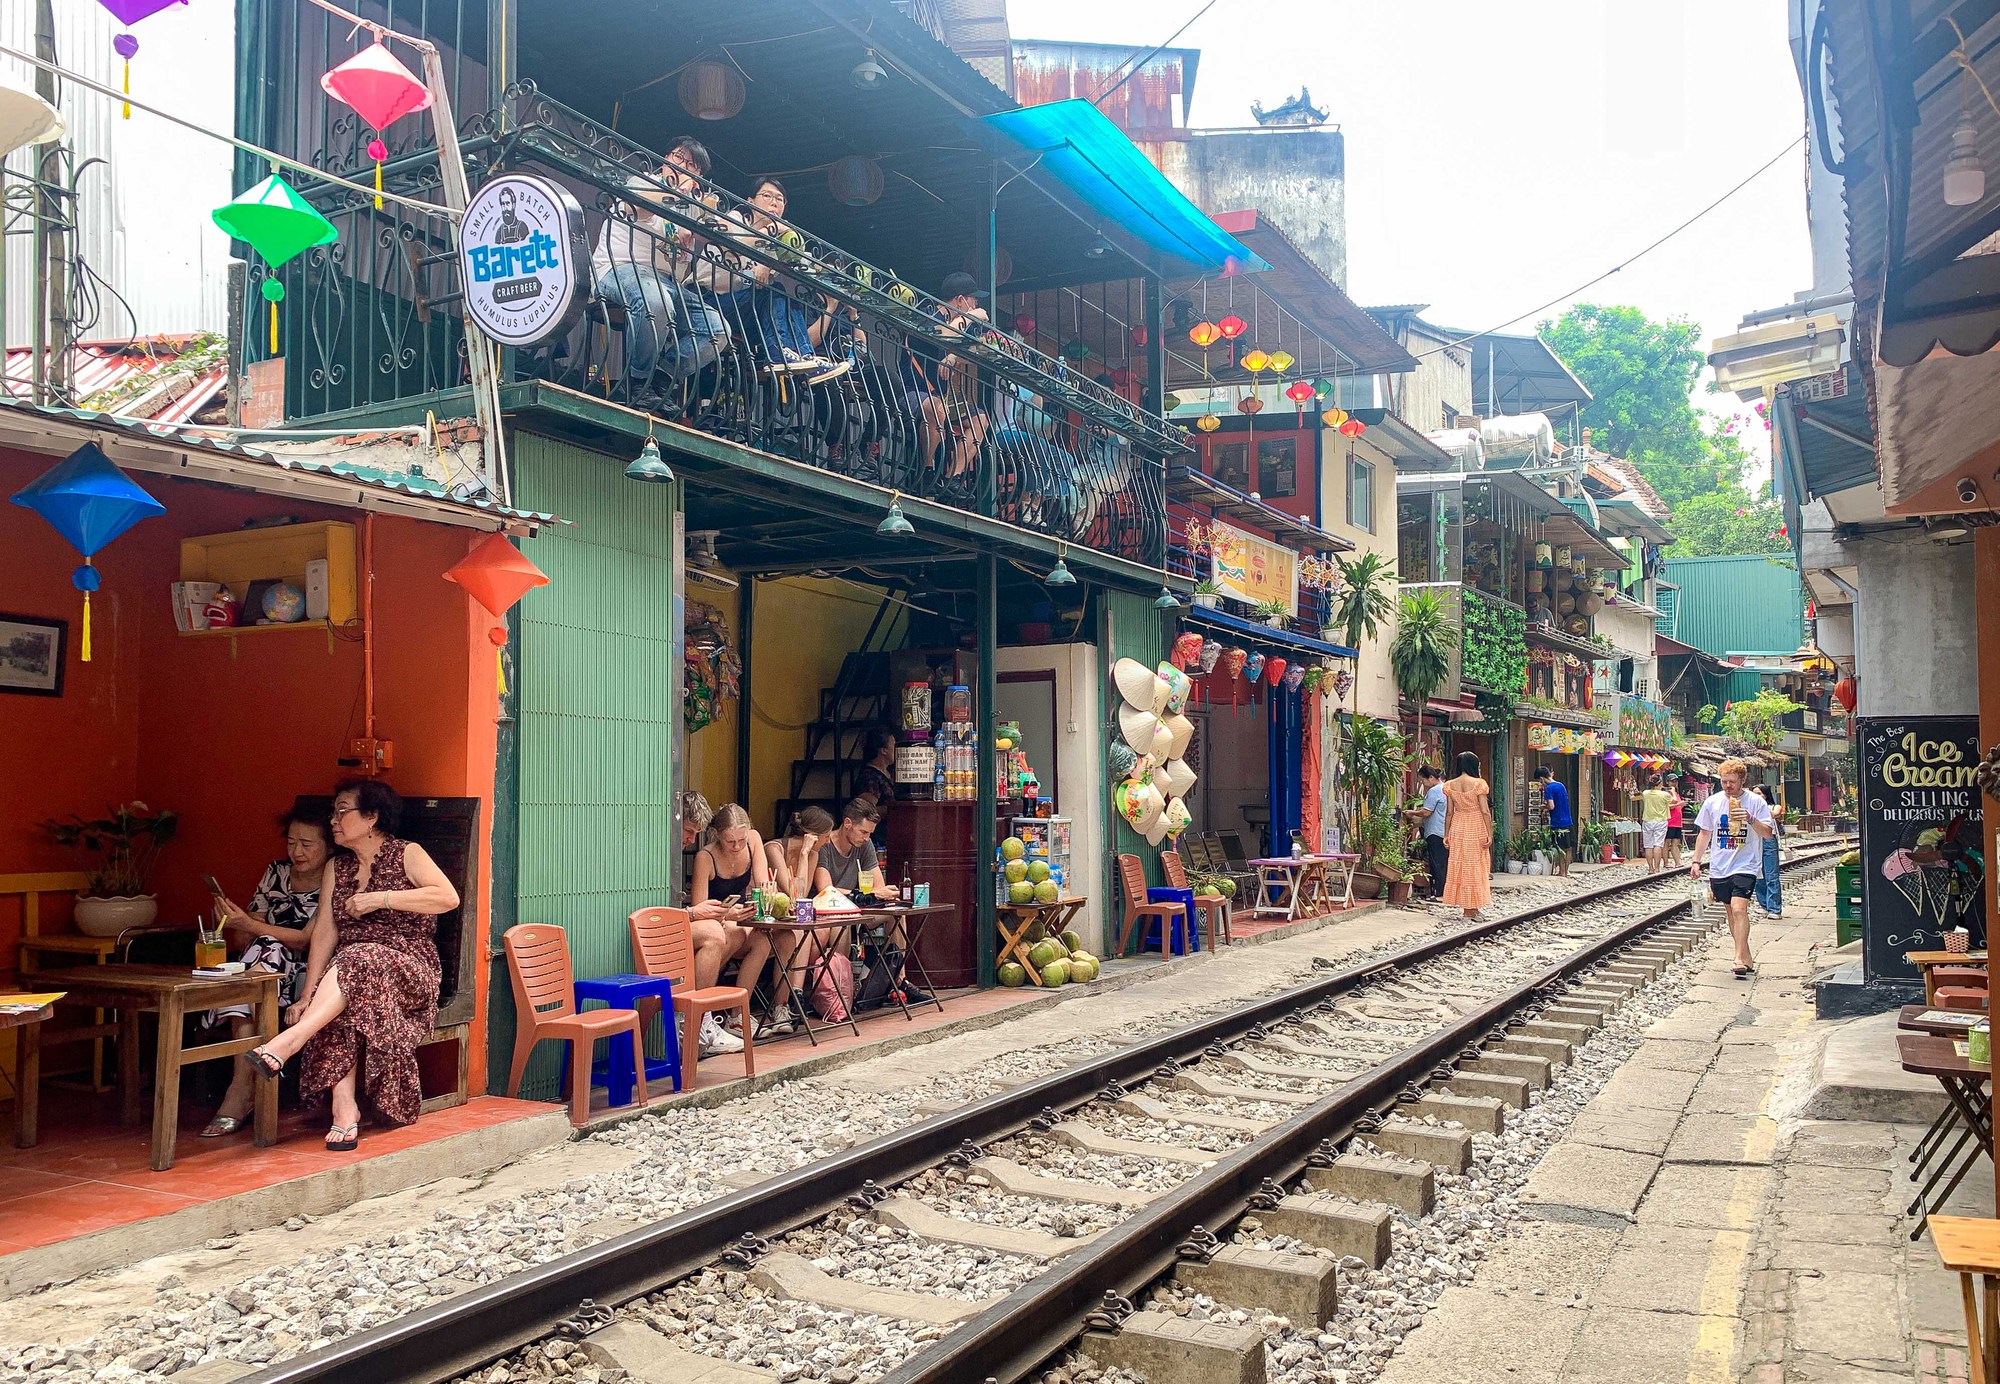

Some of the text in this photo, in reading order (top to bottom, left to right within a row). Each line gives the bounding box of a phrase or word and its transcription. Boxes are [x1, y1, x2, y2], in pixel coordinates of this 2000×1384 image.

[470, 191, 551, 237] SMALL BATCH
[467, 229, 559, 282] Barett
[477, 283, 559, 328] HUMULUS LUPULUS
[496, 281, 539, 298] CRAFT BEER
[1867, 726, 1905, 748] The Best
[1901, 731, 1964, 763] Ice
[1882, 752, 1979, 788] Cream
[1883, 808, 1945, 821] DELICIOUS
[1900, 791, 1969, 807] SELLING
